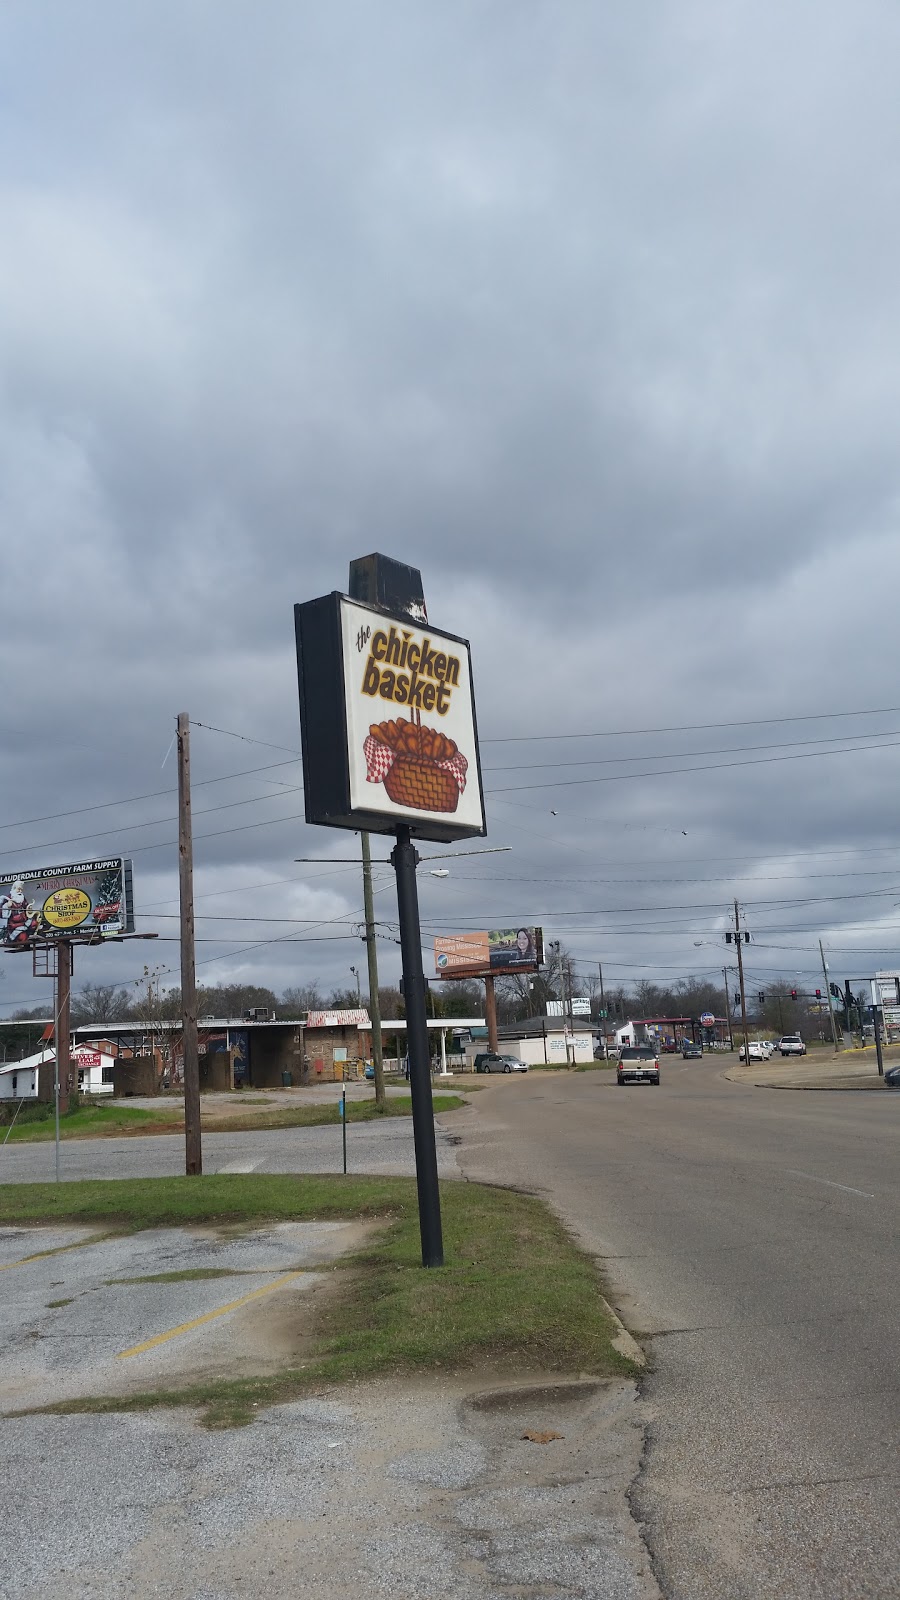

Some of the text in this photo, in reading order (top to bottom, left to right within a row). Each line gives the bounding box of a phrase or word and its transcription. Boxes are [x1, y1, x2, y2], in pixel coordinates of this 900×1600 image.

[356, 625, 460, 687] the chicken
[361, 655, 454, 716] basket
[0, 860, 119, 883] LAUDERDALE COUNTY FARM SUPPLY
[45, 901, 88, 912] CHRISTMAS
[58, 910, 75, 918] SHOP
